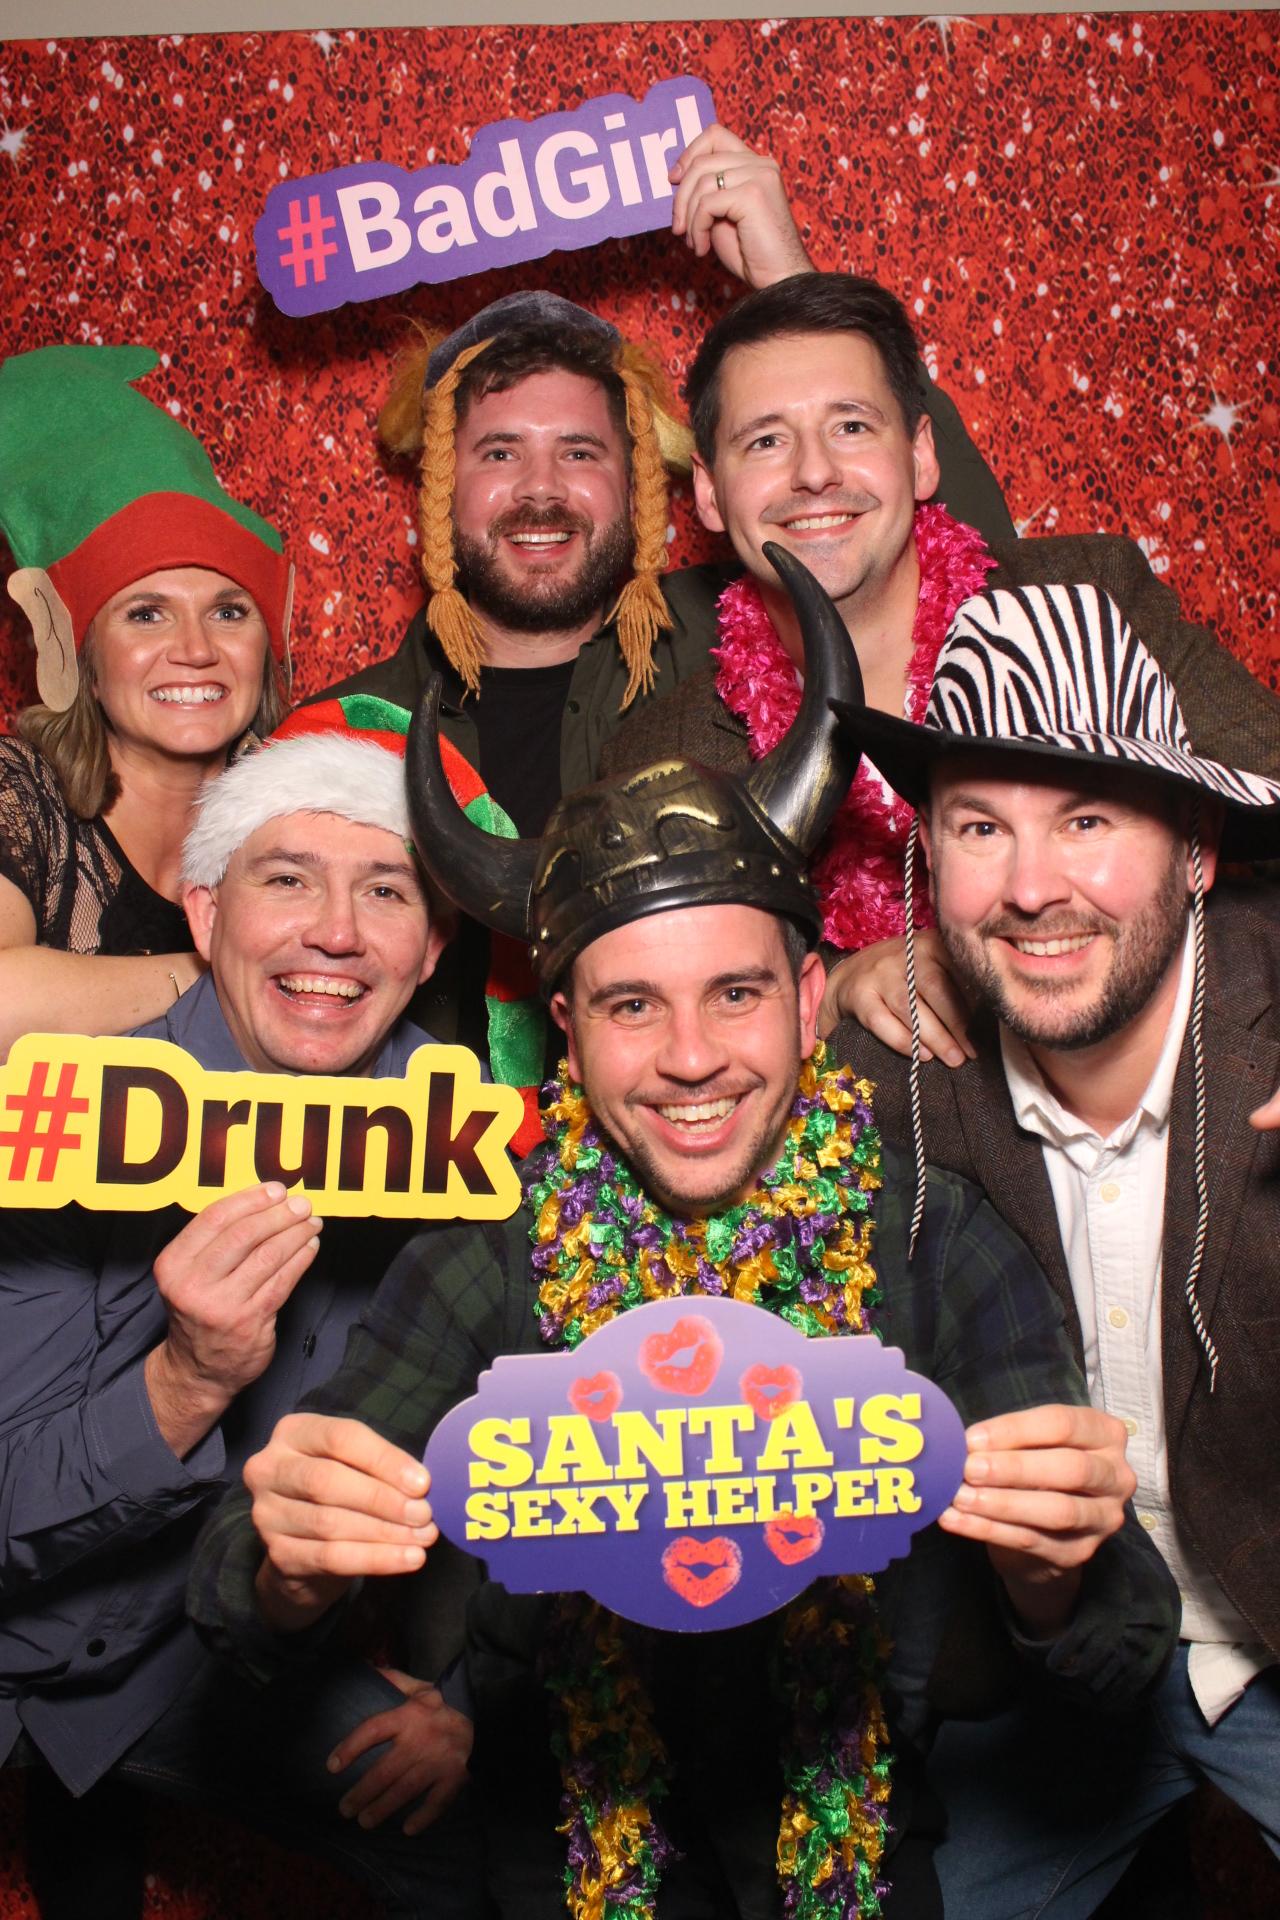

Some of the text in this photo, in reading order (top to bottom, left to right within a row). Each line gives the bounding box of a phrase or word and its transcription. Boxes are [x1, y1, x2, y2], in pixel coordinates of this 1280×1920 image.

[0, 1061, 499, 1195] #Drunk
[467, 1393, 924, 1488] SANTA'S
[465, 1468, 922, 1540] SEXY HELPER
